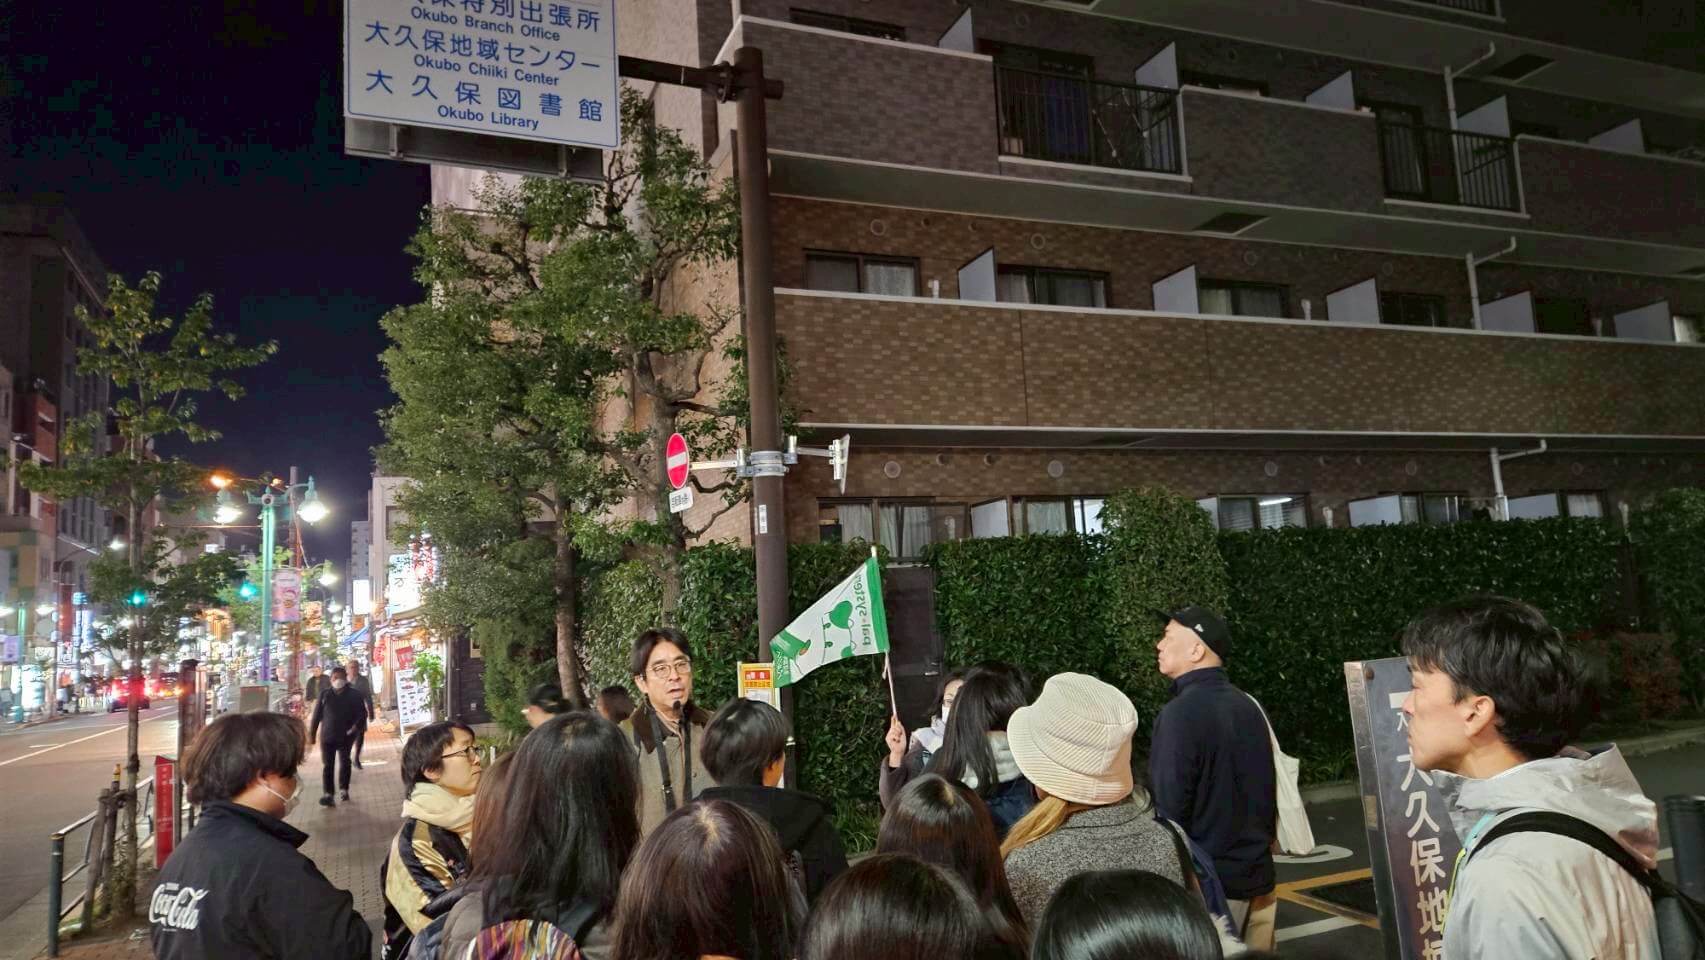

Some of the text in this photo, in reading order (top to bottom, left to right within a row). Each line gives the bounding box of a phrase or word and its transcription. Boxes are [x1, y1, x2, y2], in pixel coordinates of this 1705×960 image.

[411, 6, 561, 42] Okubo Branch Office
[417, 0, 601, 33] 特別出張所
[364, 20, 600, 72] 大久保地域センター
[414, 54, 560, 86] Okubo Chiiki Center
[365, 69, 603, 122] 大久保図書館
[437, 105, 539, 131] Okubo Library
